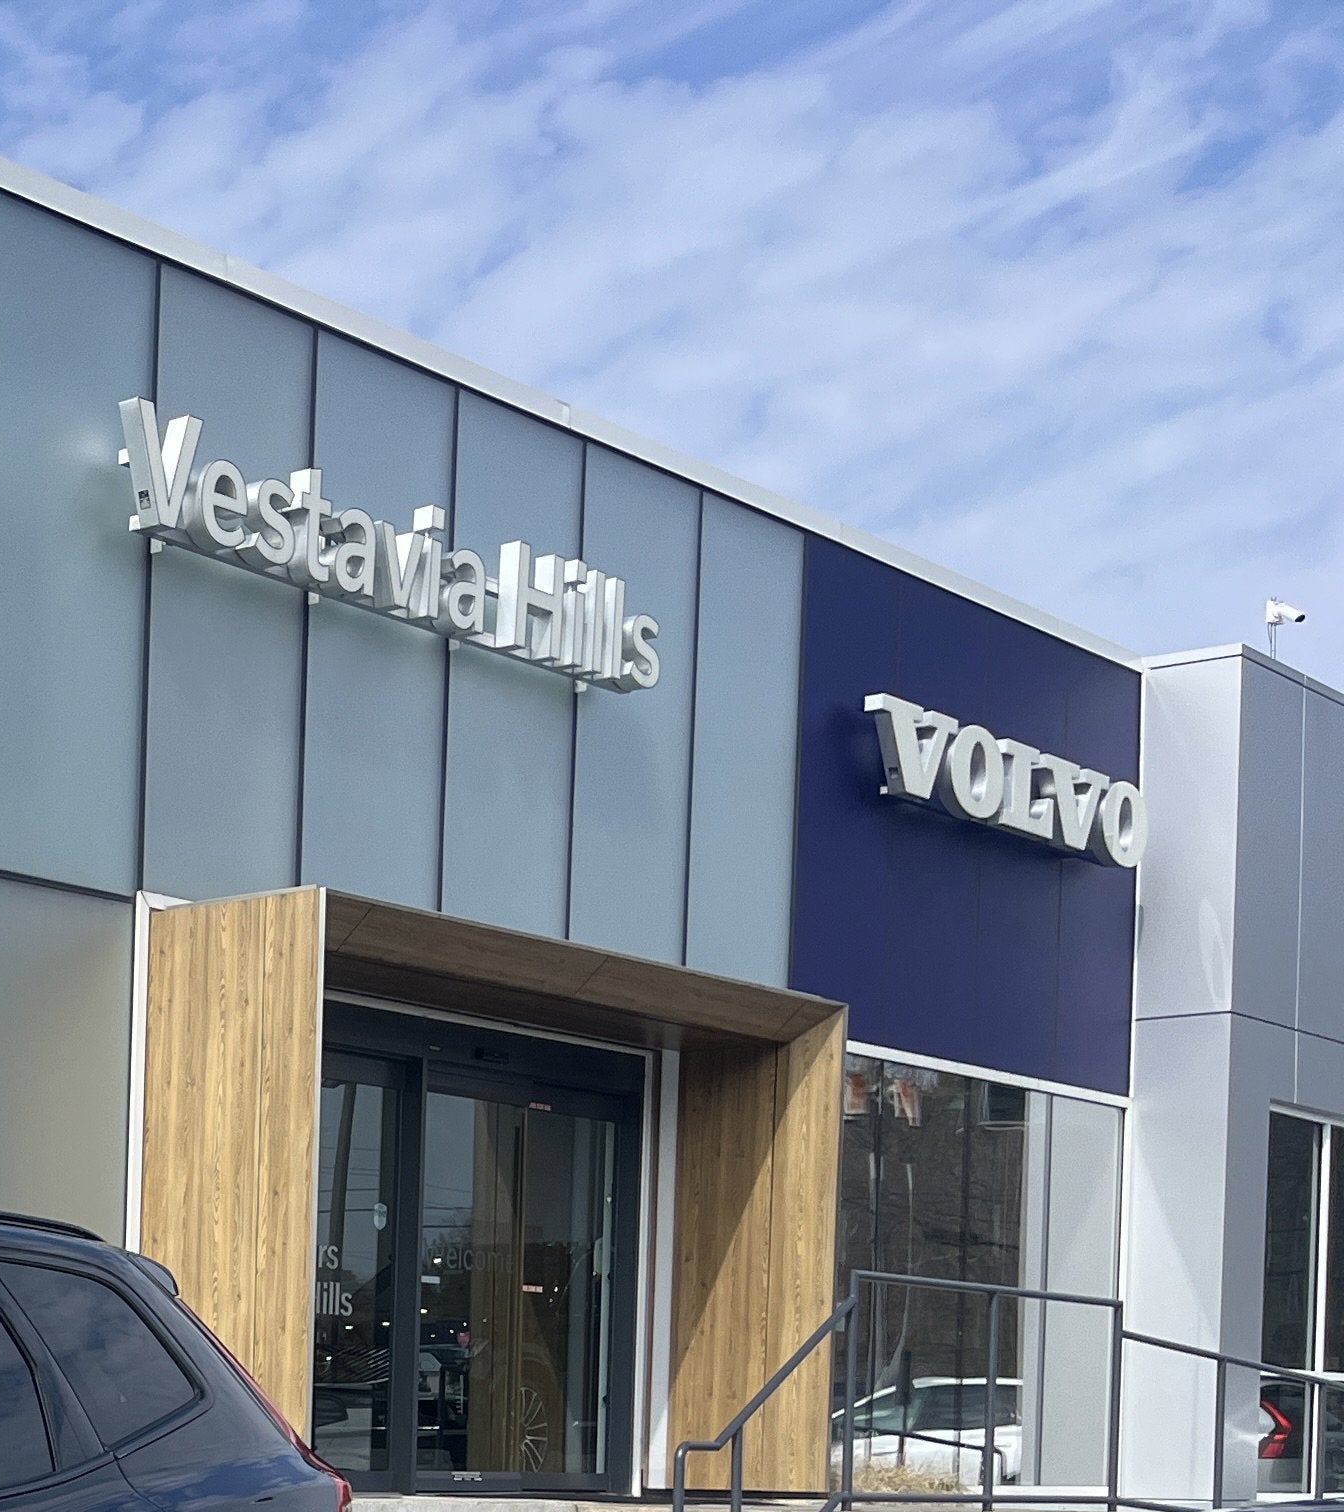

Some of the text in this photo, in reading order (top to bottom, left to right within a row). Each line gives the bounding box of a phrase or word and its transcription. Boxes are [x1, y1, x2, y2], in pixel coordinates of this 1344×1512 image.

[118, 396, 660, 694] Vestavia Hills
[864, 693, 1148, 868] VOLVO
[318, 1245, 339, 1270] rs
